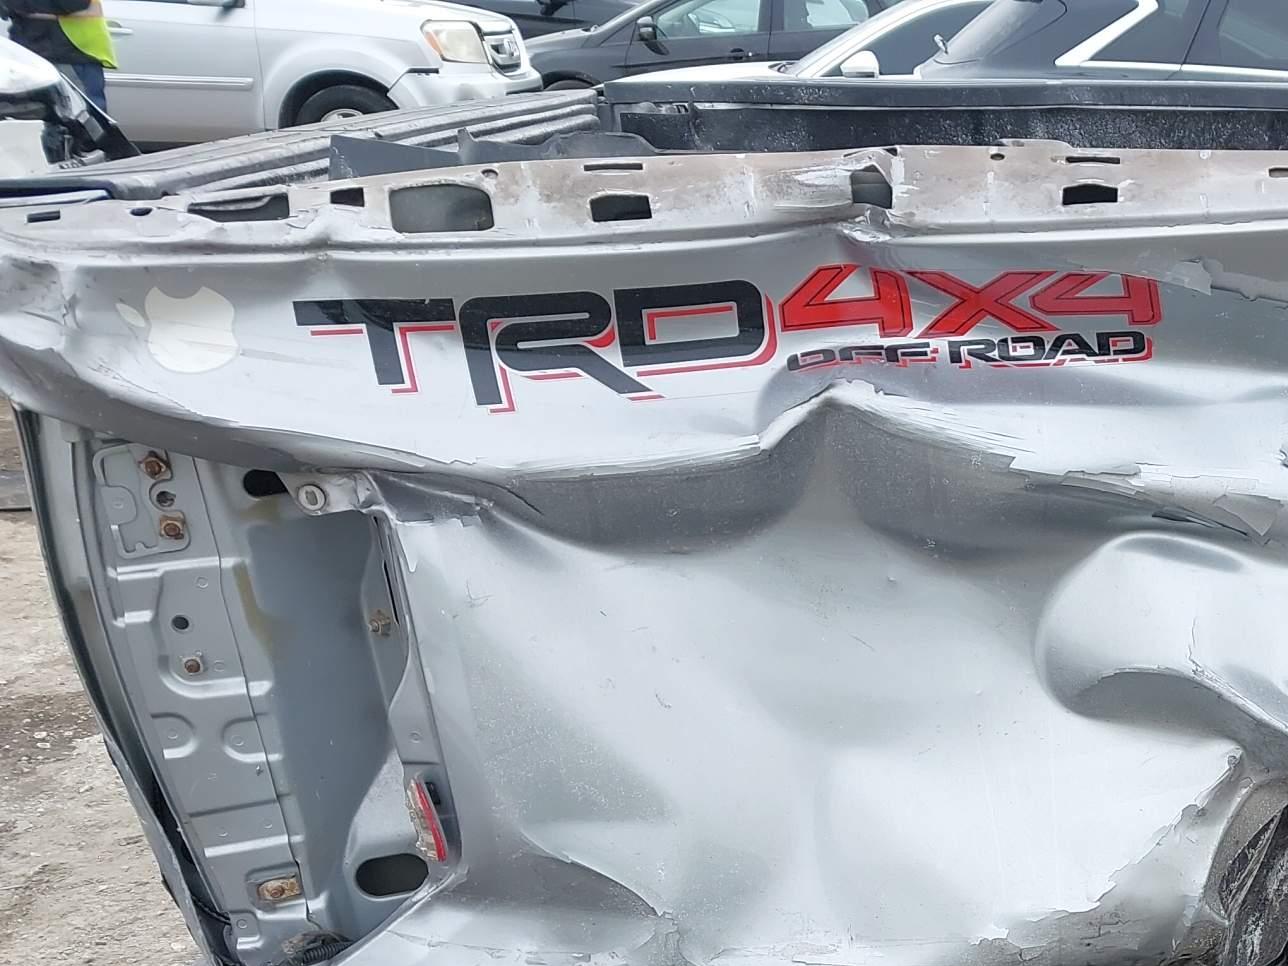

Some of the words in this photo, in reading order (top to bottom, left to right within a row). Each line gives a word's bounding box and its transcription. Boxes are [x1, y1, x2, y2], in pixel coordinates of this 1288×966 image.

[291, 278, 773, 414] TRD
[786, 341, 939, 373] OFF
[947, 329, 1153, 370] ROAD
